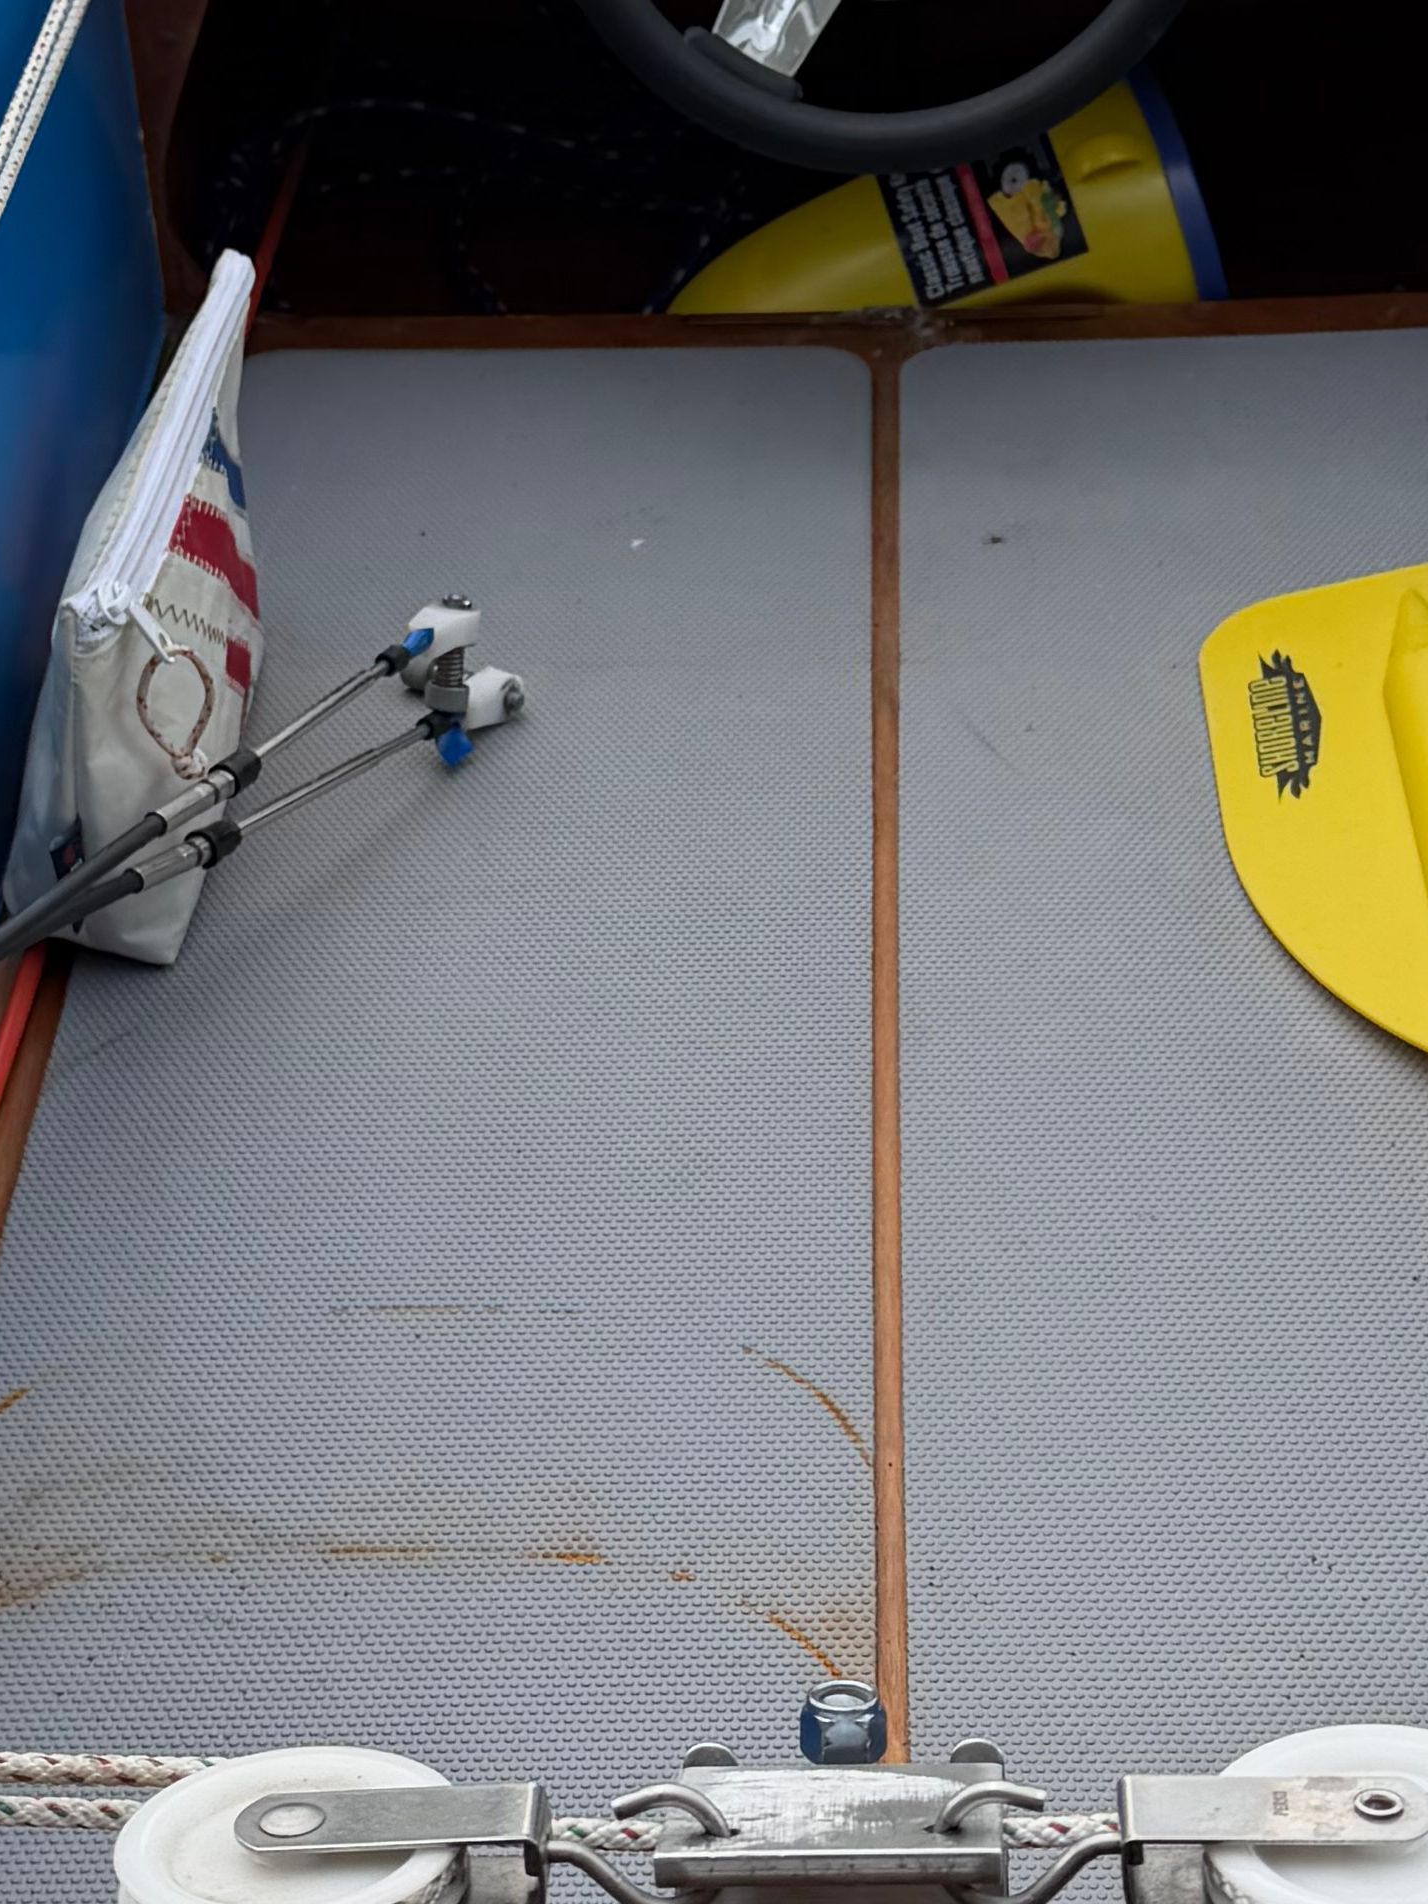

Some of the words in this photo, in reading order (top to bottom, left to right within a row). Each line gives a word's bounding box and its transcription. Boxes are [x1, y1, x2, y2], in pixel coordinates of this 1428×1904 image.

[895, 183, 920, 223] Safety
[907, 220, 930, 251] Boat
[929, 222, 948, 240] de
[917, 249, 945, 300] Classic
[935, 238, 965, 293] Trousse
[1292, 677, 1315, 764] MARINE
